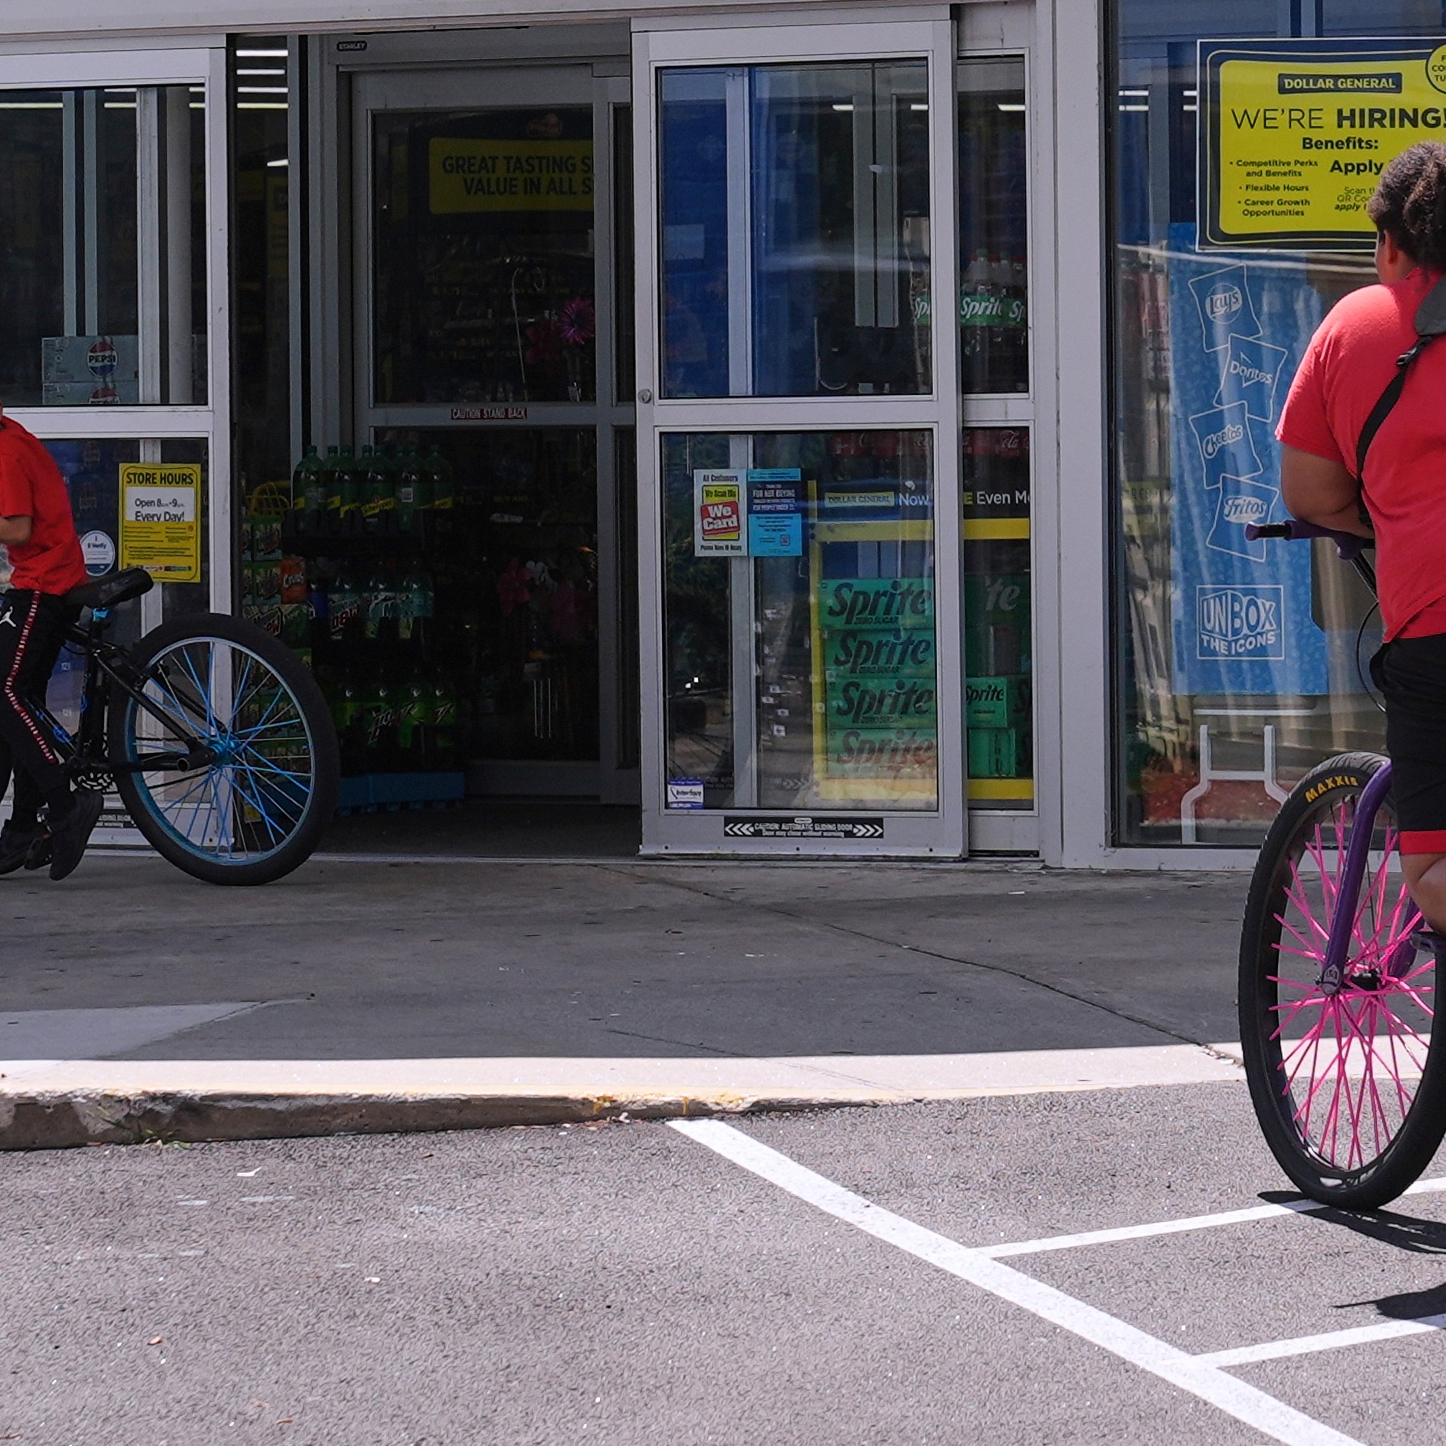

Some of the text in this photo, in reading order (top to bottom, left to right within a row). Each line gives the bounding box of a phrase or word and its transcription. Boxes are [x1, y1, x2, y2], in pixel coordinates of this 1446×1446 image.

[1284, 78, 1396, 89] DOLLAR GENERAL
[1231, 108, 1324, 129] WE'RE
[1302, 137, 1379, 150] Benefits:
[442, 156, 498, 174] GREAT
[503, 156, 576, 174] TASTING
[1236, 159, 1319, 167] Competitive Perks
[1329, 159, 1384, 175] Apply
[463, 177, 518, 195] VALUE
[523, 177, 541, 195] IN
[547, 177, 577, 195] ALL
[1245, 184, 1309, 192] Flexible Hours
[1344, 186, 1366, 195] Scan
[1242, 209, 1305, 217] Opportunities
[1334, 203, 1362, 212] apply
[88, 354, 116, 363] PEPSI
[1229, 360, 1272, 384] Doritos
[452, 407, 527, 419] CAUTION STAND BACK
[1205, 426, 1242, 456] Cheetos
[126, 472, 194, 485] STORE HOURS
[134, 498, 155, 509] Open
[899, 492, 930, 506] Now
[977, 491, 1011, 504] Even
[1225, 497, 1266, 516] Fritos
[135, 510, 185, 522] Every Day!
[707, 504, 732, 517] We
[703, 514, 737, 530] Card
[828, 580, 931, 625] Sprite
[1202, 590, 1276, 639] UNBOX
[834, 629, 931, 674] Sprite
[1201, 632, 1276, 655] THE ICONS
[836, 680, 934, 724] Sprite
[965, 685, 1005, 705] Sprite
[837, 730, 934, 771] Sprite
[1305, 775, 1359, 803] MAXXIS
